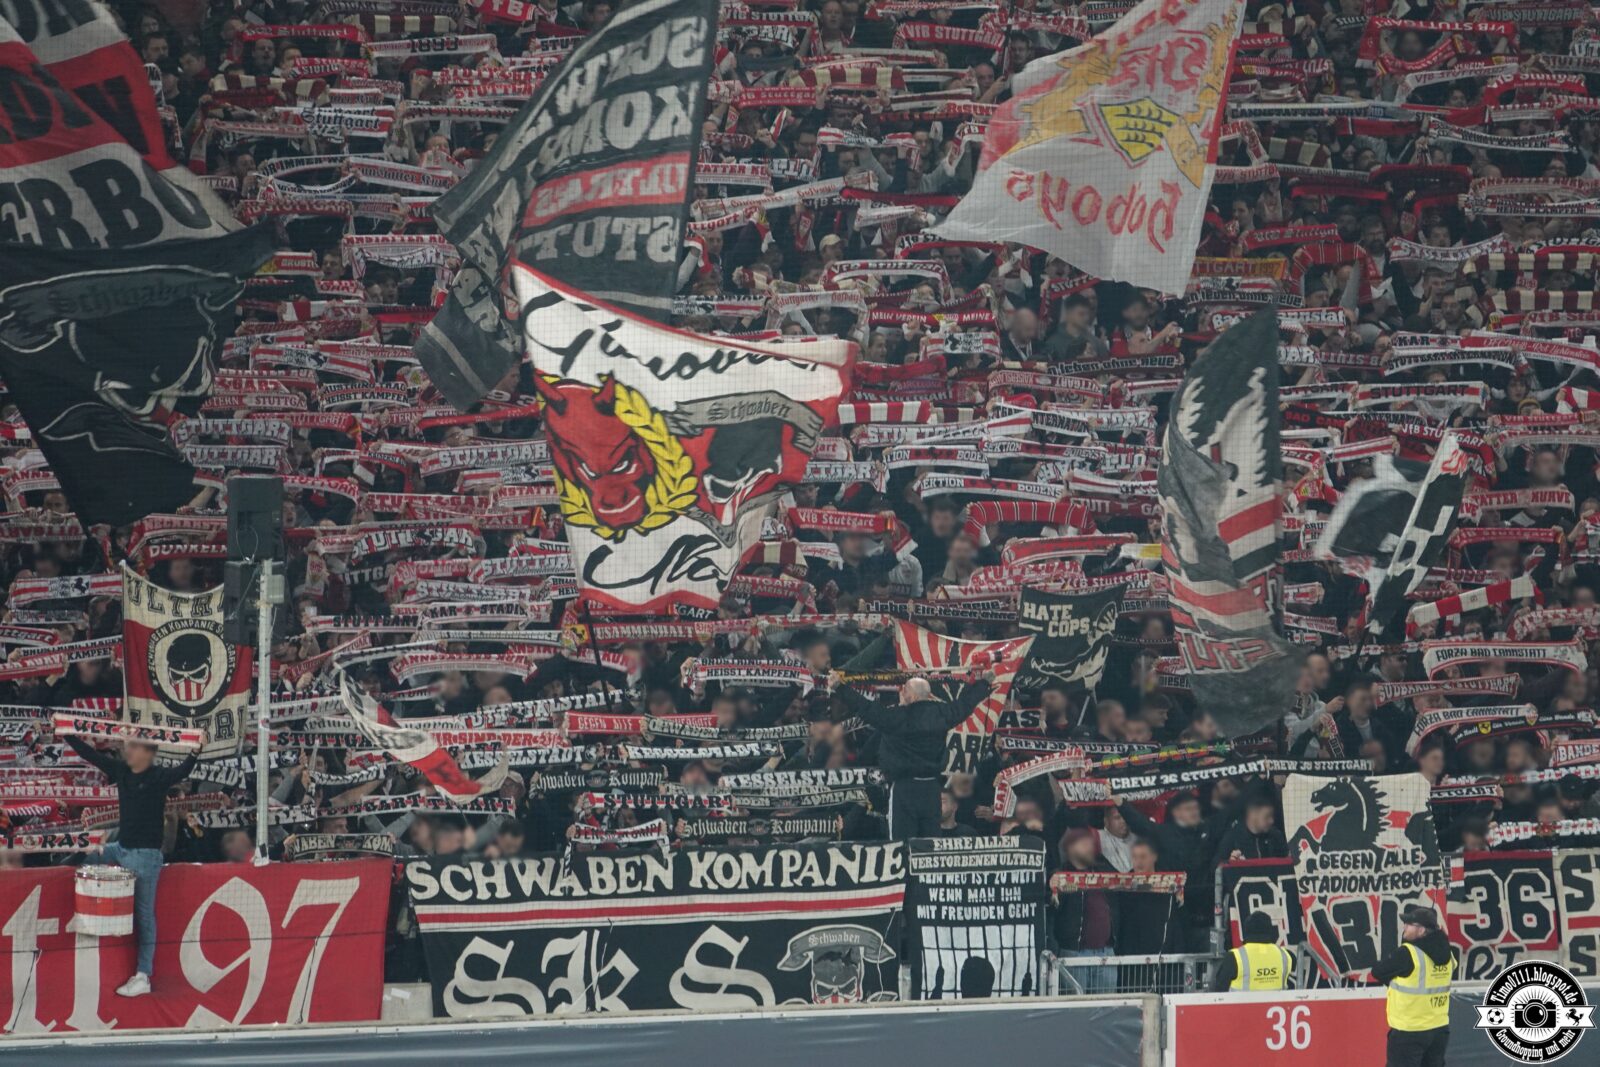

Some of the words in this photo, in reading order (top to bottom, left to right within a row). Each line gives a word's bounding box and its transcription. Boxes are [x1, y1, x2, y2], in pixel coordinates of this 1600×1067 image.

[301, 107, 381, 130] Stuttgart
[962, 312, 990, 321] MEINE
[1371, 385, 1467, 398] STUTTGART
[708, 398, 790, 422] Schwaben
[800, 512, 818, 523] VfB
[822, 513, 875, 529] Stuttgart
[127, 575, 225, 618] ULTR
[1023, 601, 1073, 620] HATE
[169, 620, 214, 633] KOMPANIE
[1048, 617, 1091, 637] COPS
[1436, 647, 1468, 661] FORZA
[1470, 647, 1491, 658] BAD
[1494, 647, 1547, 658] CANNSTATT
[1001, 711, 1040, 728] AS
[1414, 711, 1442, 737] FORZA
[1112, 774, 1157, 790] CREW
[1181, 759, 1267, 783] STUTTGART
[1267, 759, 1297, 771] CREW
[1314, 759, 1374, 772] STUTTGART
[724, 768, 867, 789] KESSELSTADT
[683, 818, 748, 838] Schwaben
[770, 817, 839, 837] Kompanie
[934, 837, 972, 850] EHRE
[974, 836, 1019, 849] ALLEN
[911, 854, 998, 869] VERSTORBENEN
[1000, 854, 1042, 867] ULTRAS
[1319, 853, 1373, 870] GEGEN
[1383, 848, 1421, 868] ALLE
[406, 852, 678, 902] SCHWABEN
[688, 841, 907, 889] KOMPANIE
[1300, 868, 1441, 894] STADIONVERBOTE
[929, 889, 962, 902] WENN
[968, 888, 995, 901] MAN
[917, 905, 936, 919] MIT
[942, 904, 1004, 920] FREUNDEN
[1008, 903, 1037, 918] GEHT
[1461, 870, 1556, 943] 36
[808, 931, 861, 945] Schwaben
[180, 876, 361, 1027] 97
[1257, 968, 1277, 977] SDS
[1266, 1006, 1311, 1050] 36
